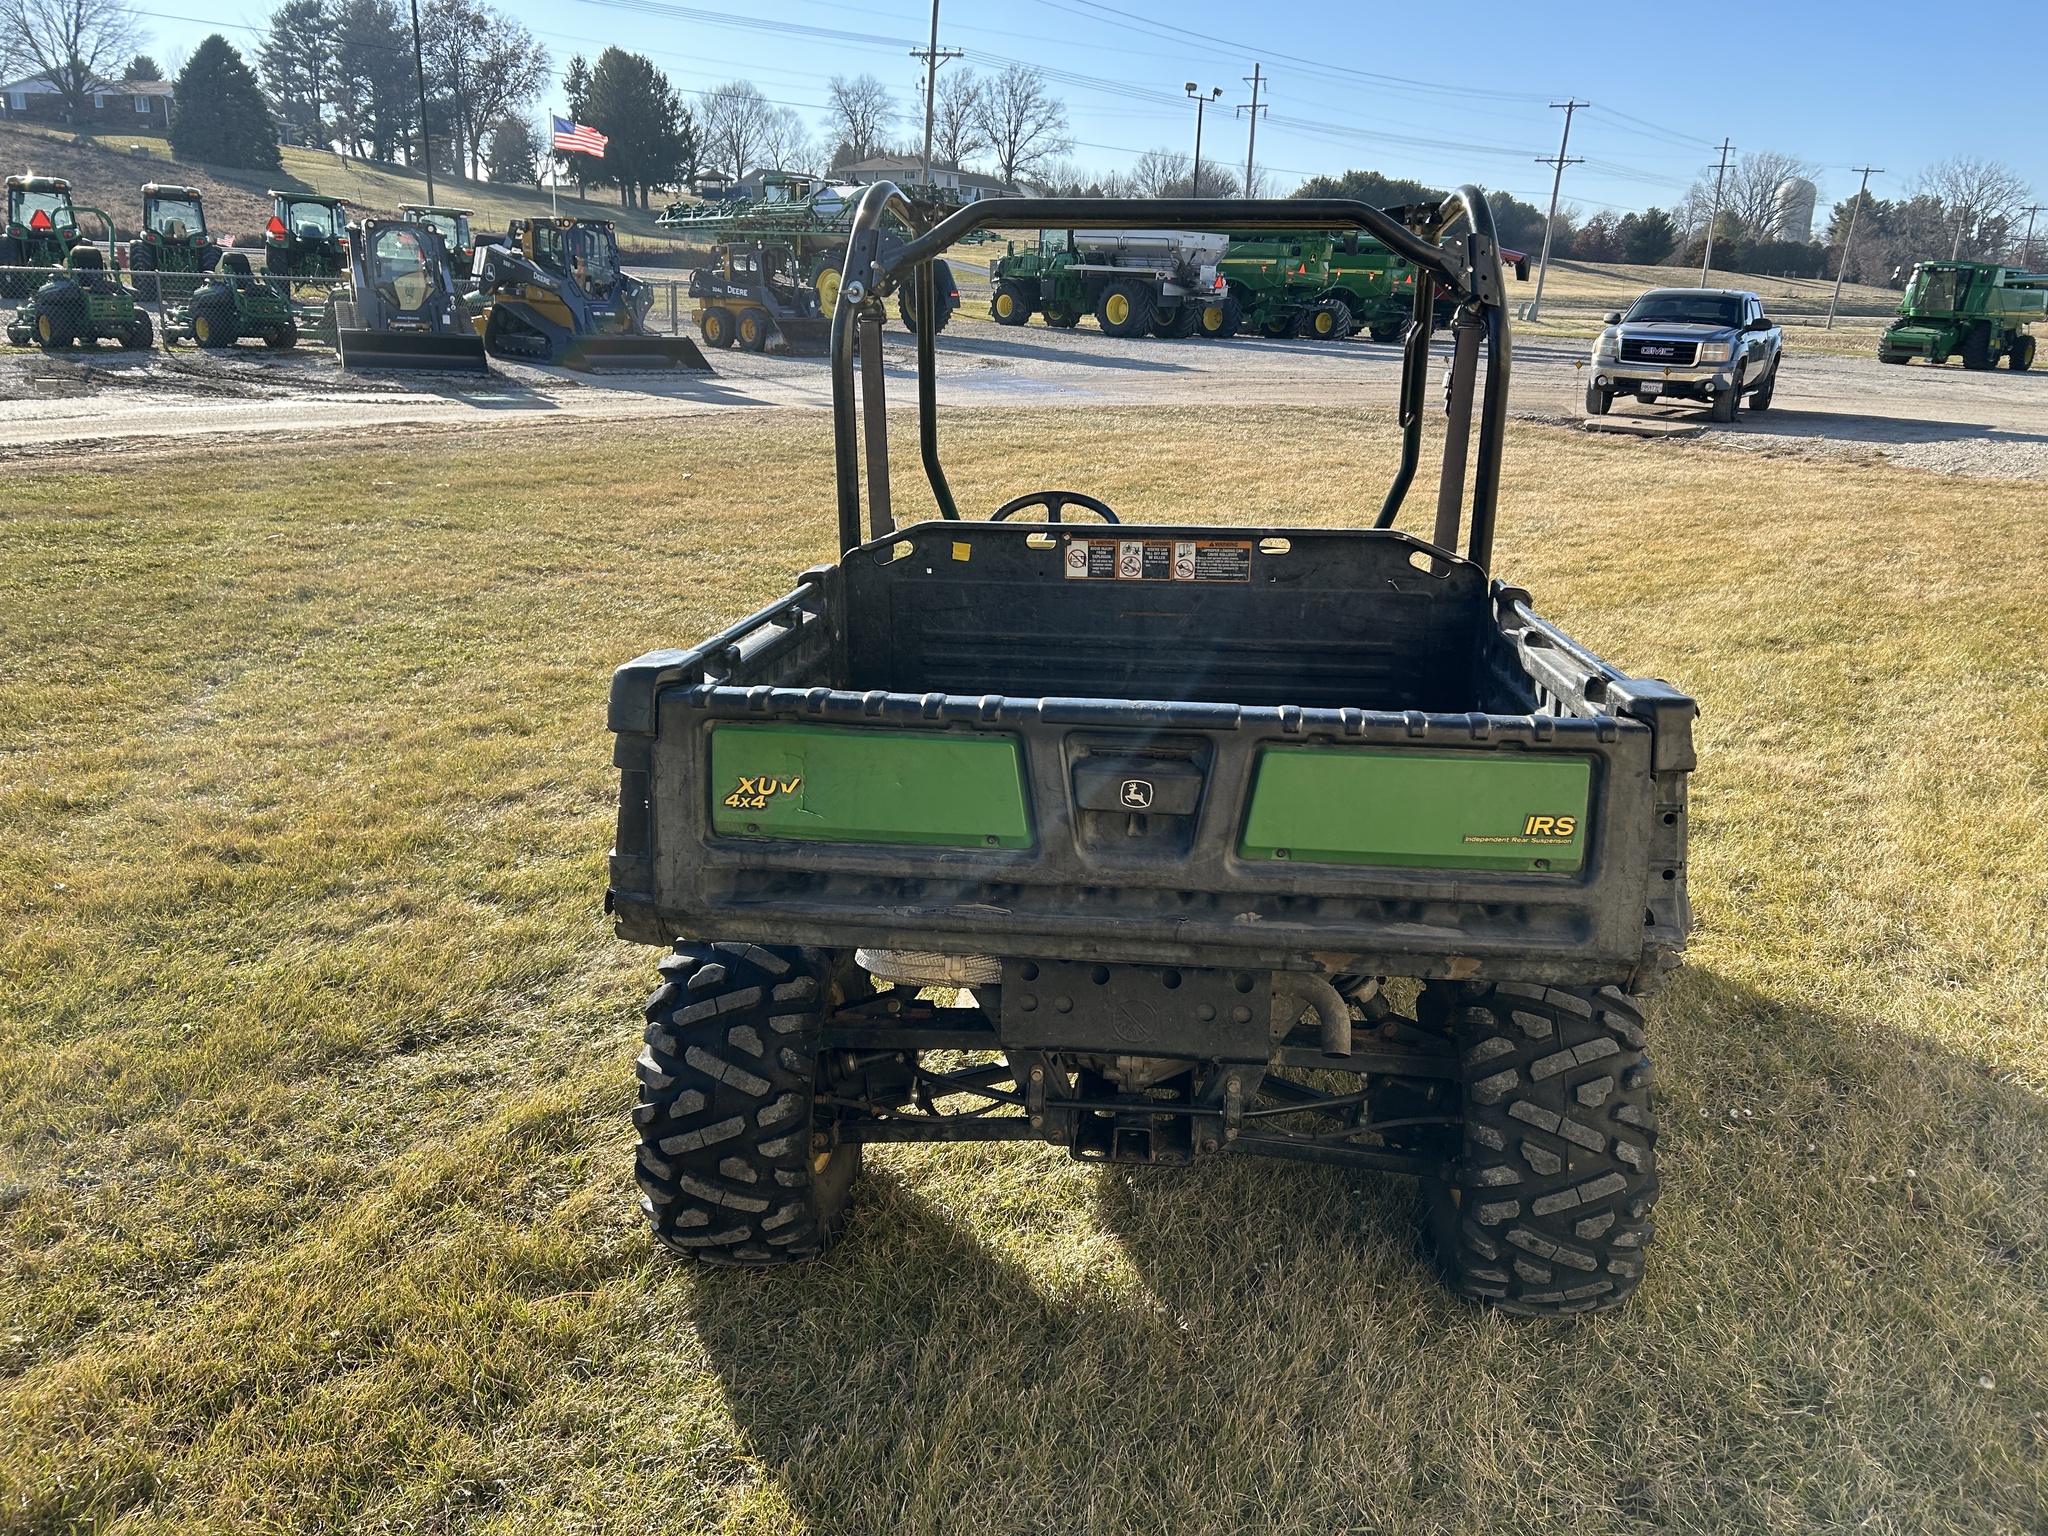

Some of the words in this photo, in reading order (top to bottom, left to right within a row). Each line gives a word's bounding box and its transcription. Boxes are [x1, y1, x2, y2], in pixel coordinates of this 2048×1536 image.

[533, 271, 551, 286] DEERE
[727, 285, 748, 297] DEERE
[1640, 346, 1675, 356] GMC
[735, 776, 802, 796] XUV
[724, 794, 767, 809] 4x4
[1524, 815, 1577, 836] IRS
[1465, 836, 1510, 844] Independent
[1530, 837, 1573, 845] Suspension
